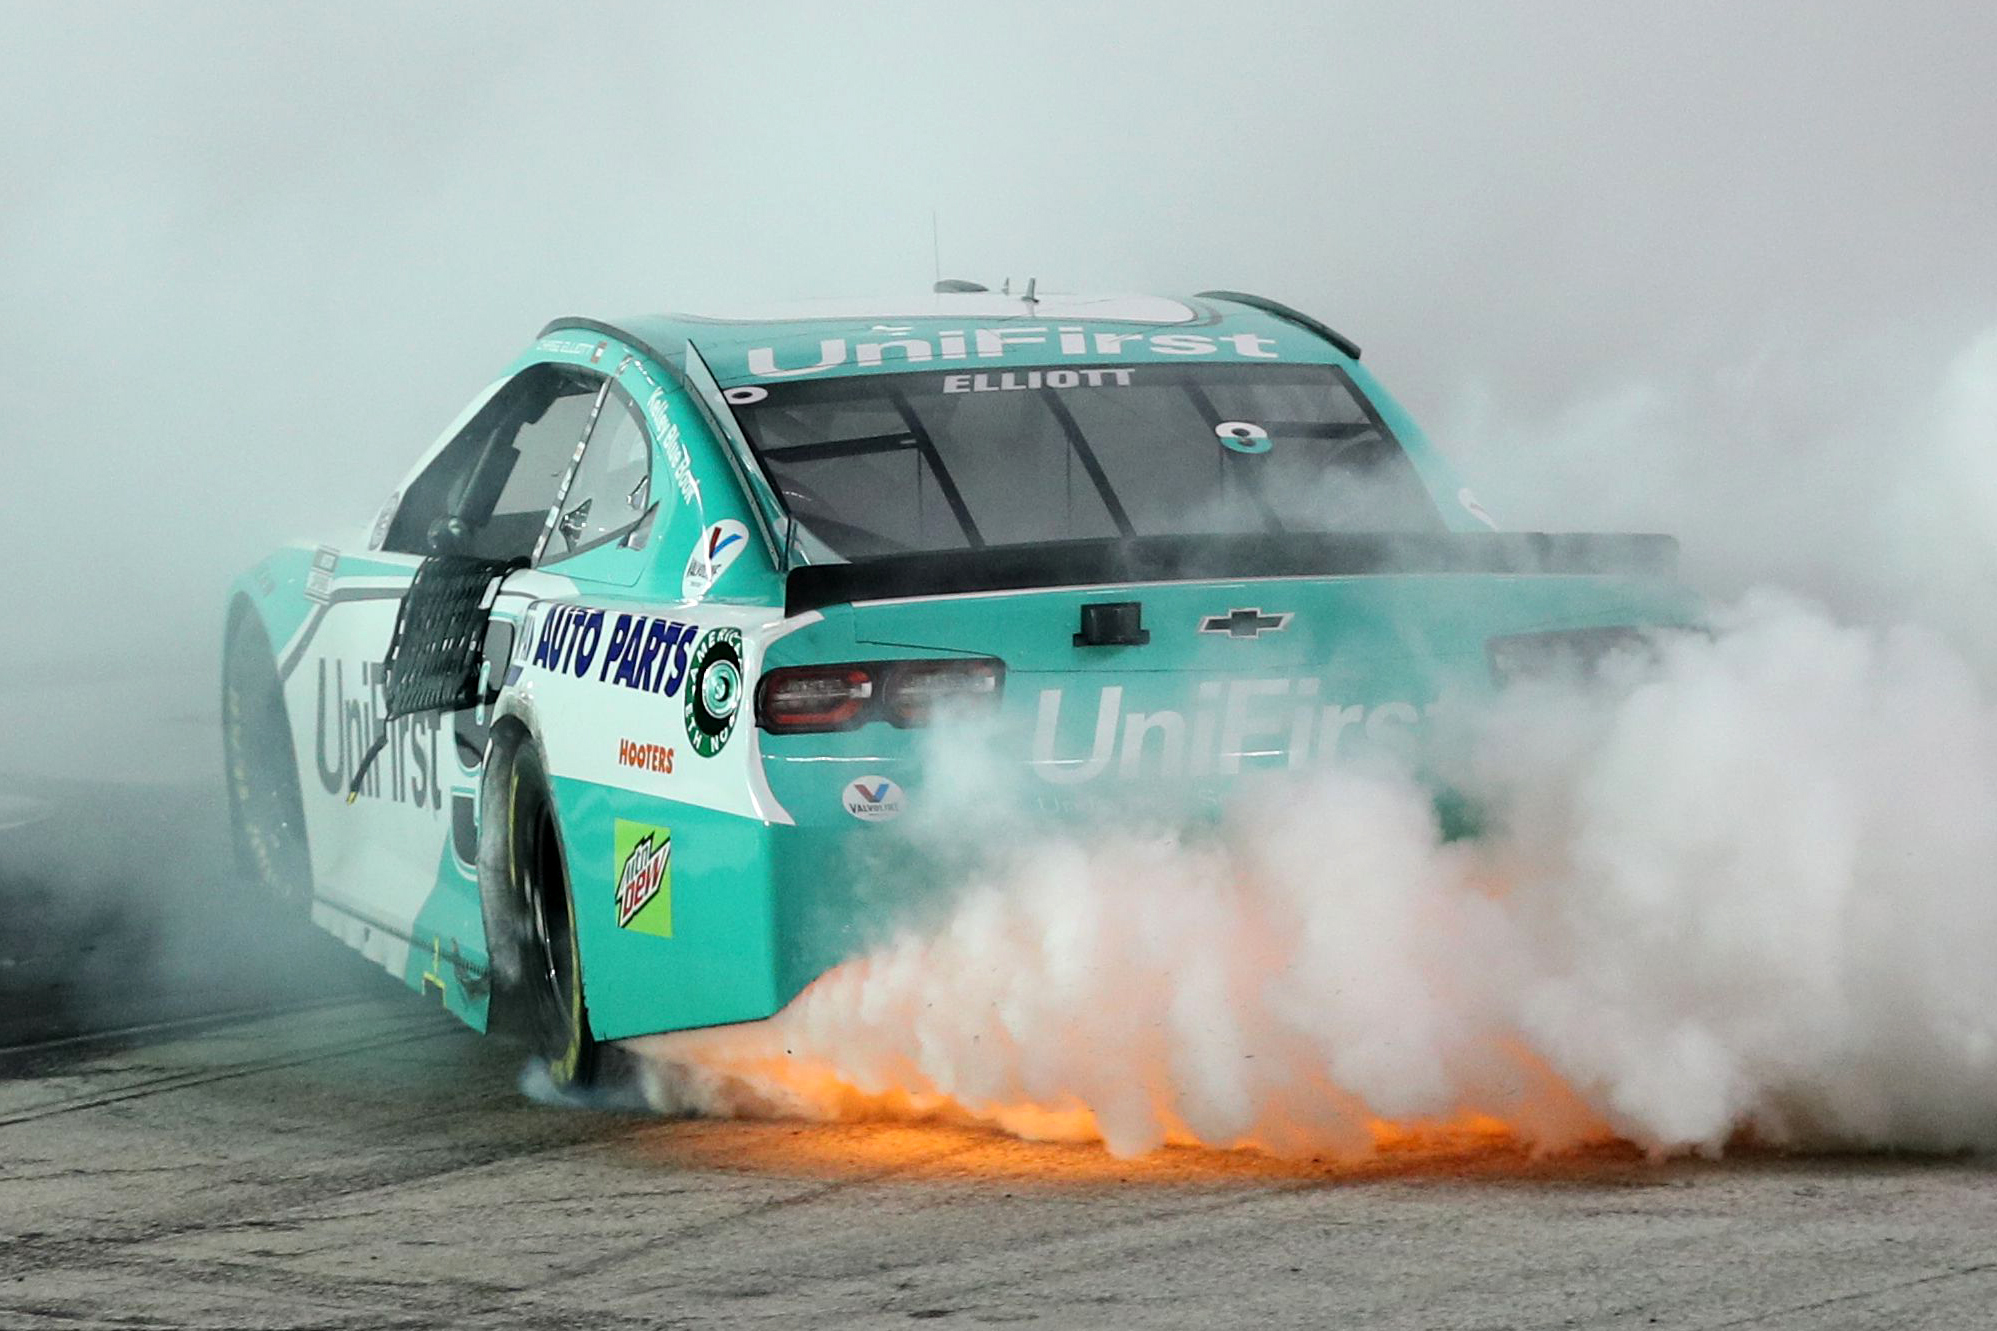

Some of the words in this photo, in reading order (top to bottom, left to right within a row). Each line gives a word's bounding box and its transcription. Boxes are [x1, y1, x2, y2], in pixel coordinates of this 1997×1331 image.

[747, 326, 1279, 378] UniFirst
[943, 368, 1136, 394] ELLIOTT
[532, 602, 605, 679] AUTO
[598, 613, 700, 698] PARTS
[618, 738, 675, 774] HOOTERS
[1031, 677, 1426, 785] UniFirs
